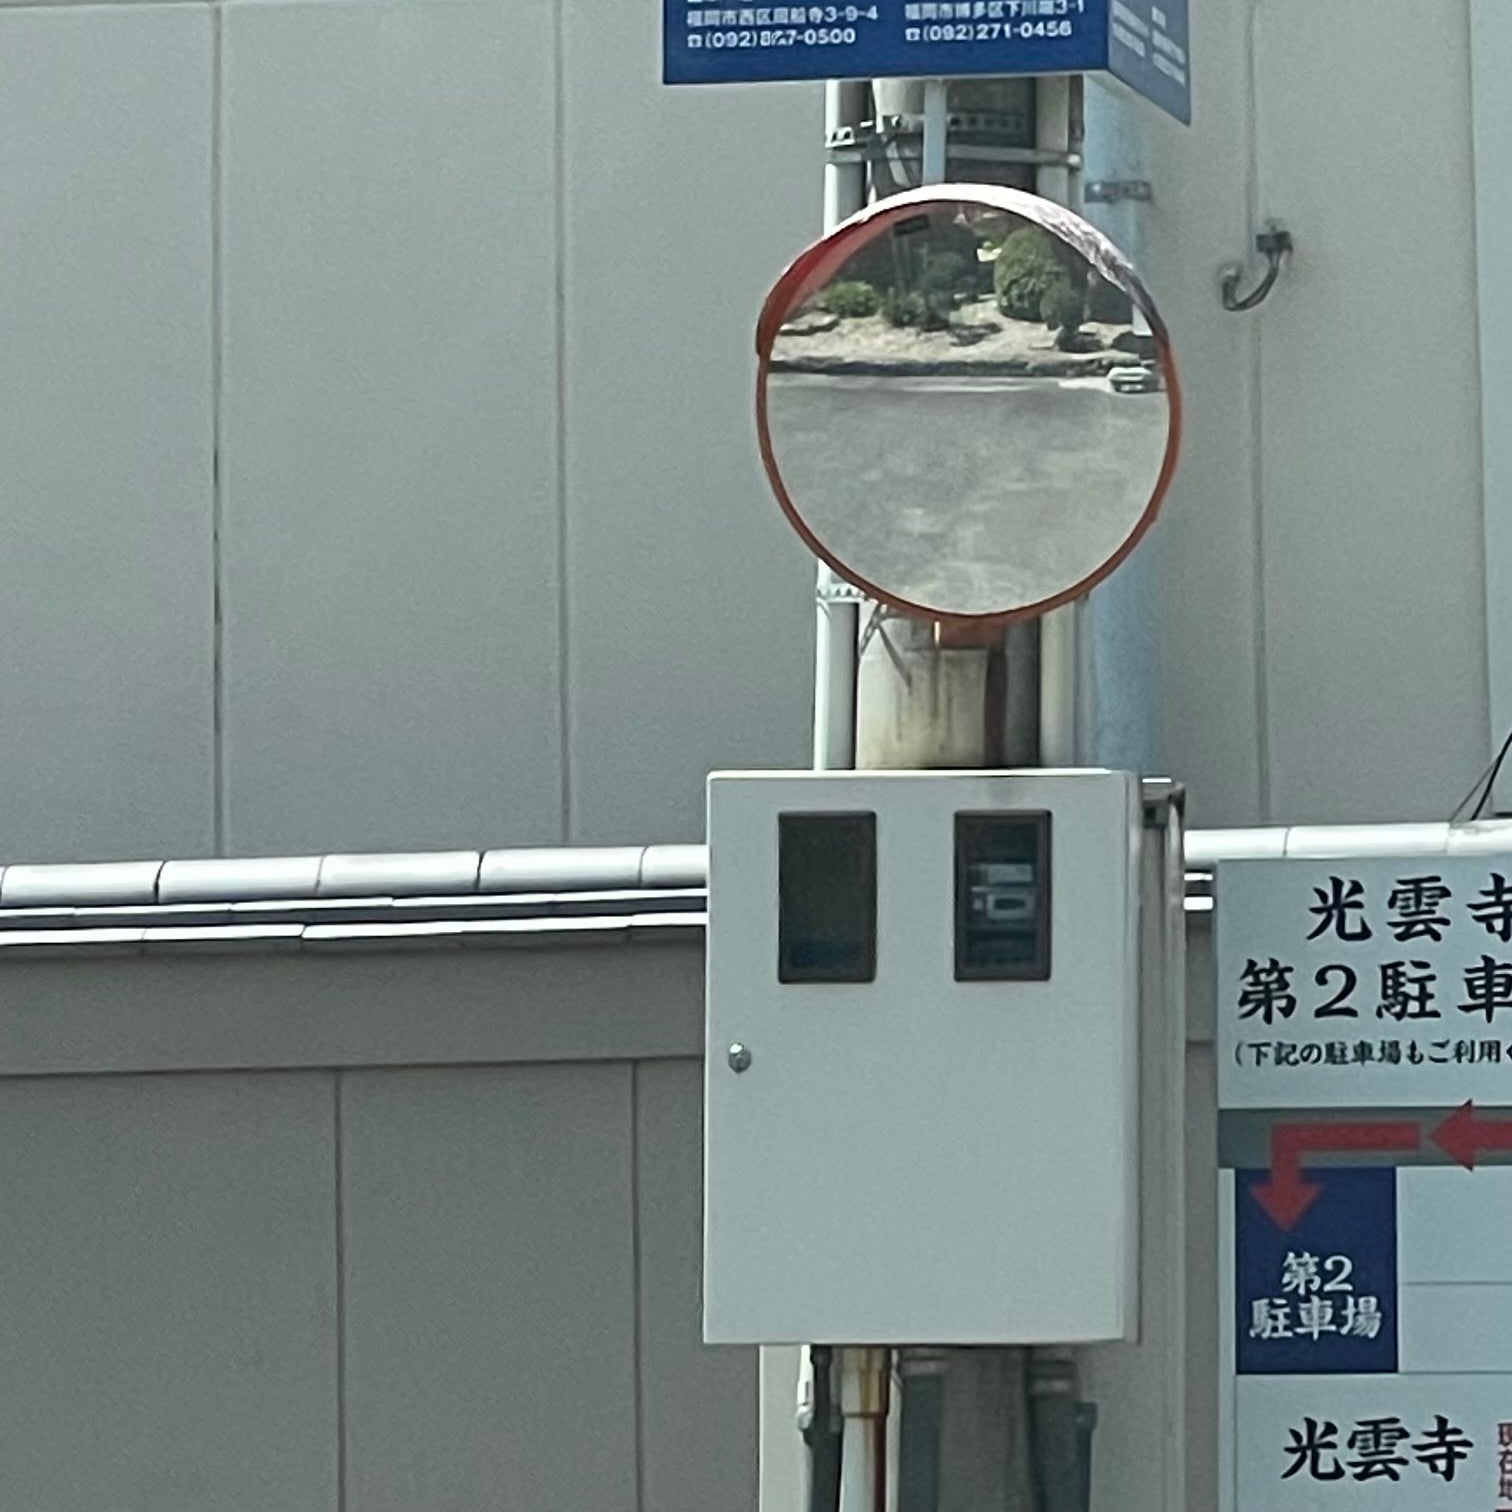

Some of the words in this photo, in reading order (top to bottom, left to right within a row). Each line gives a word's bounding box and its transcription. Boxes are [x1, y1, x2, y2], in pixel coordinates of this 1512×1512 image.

[1281, 1252, 1355, 1294] 第2
[1249, 1295, 1383, 1341] 駐車場
[1280, 1414, 1475, 1483] 光雲寺
